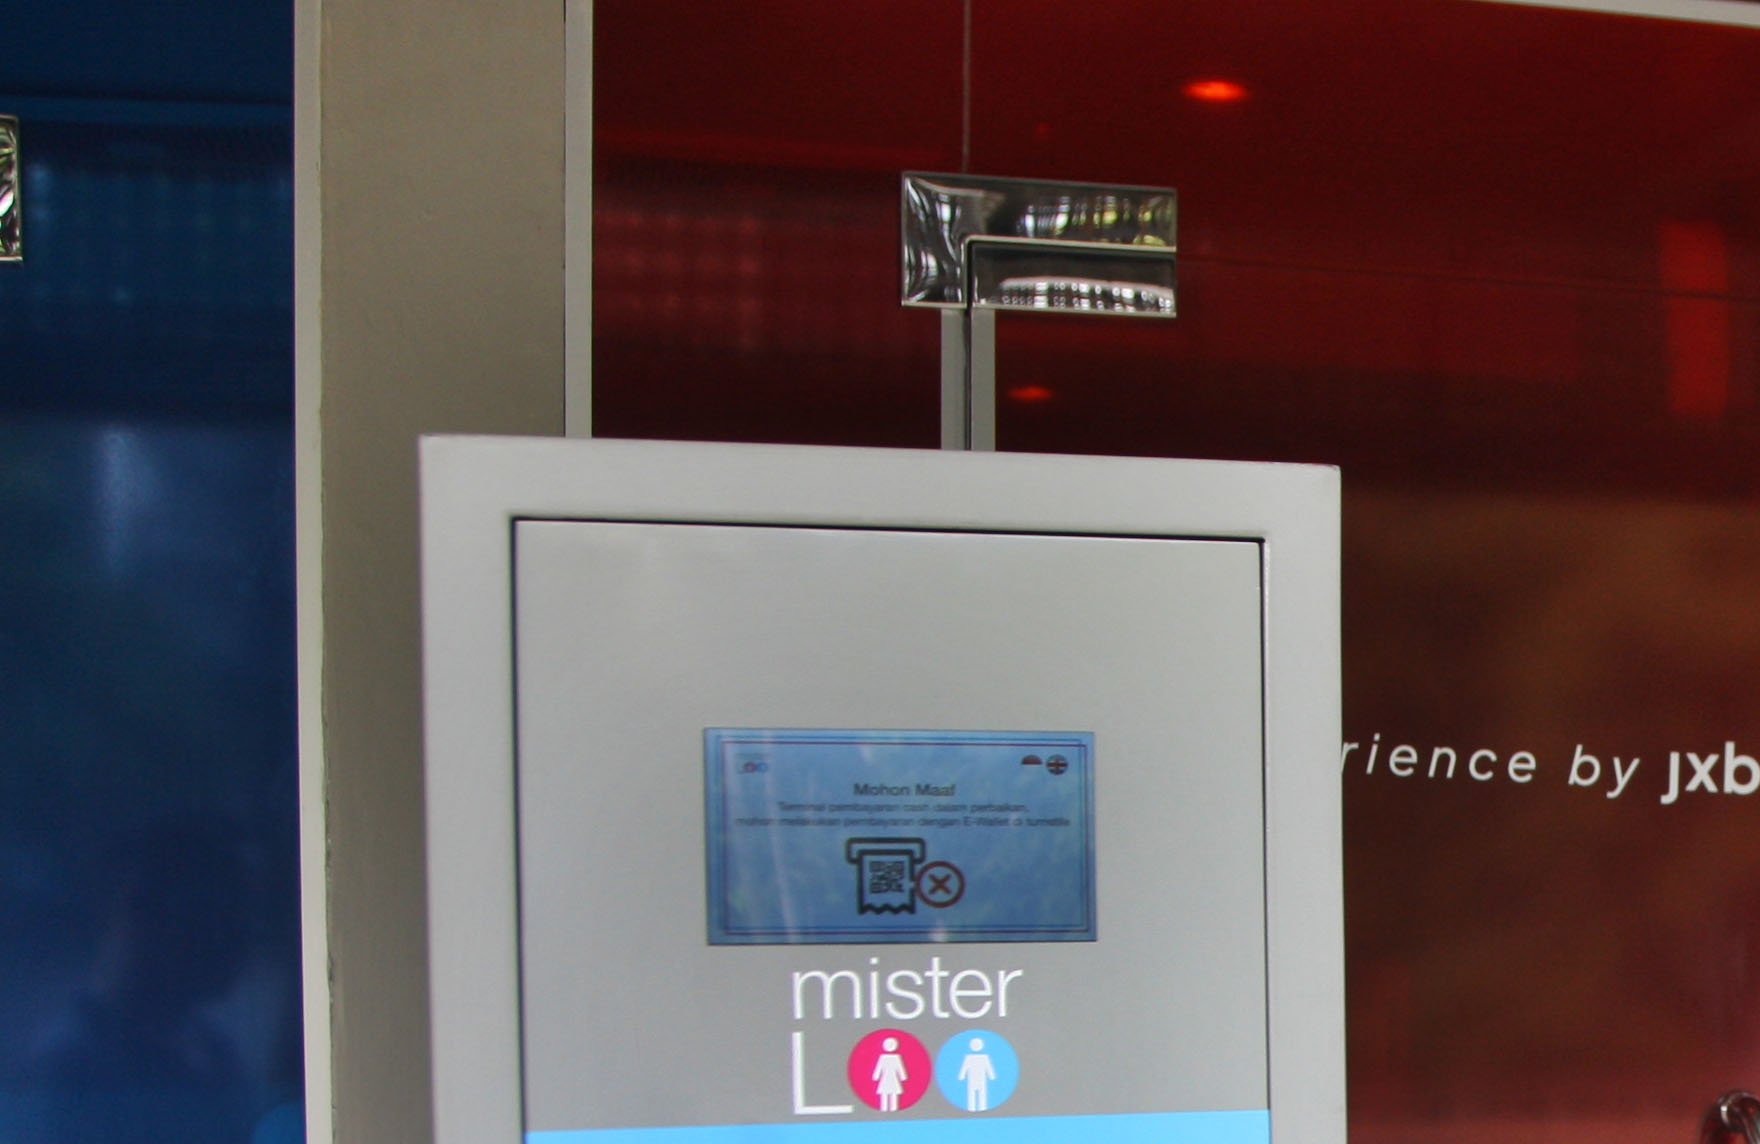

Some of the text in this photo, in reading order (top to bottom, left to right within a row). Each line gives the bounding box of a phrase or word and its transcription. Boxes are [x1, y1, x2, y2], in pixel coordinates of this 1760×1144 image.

[853, 783, 957, 796] Mohon Maaf
[1567, 743, 1640, 799] by
[792, 957, 1023, 1019] mister
